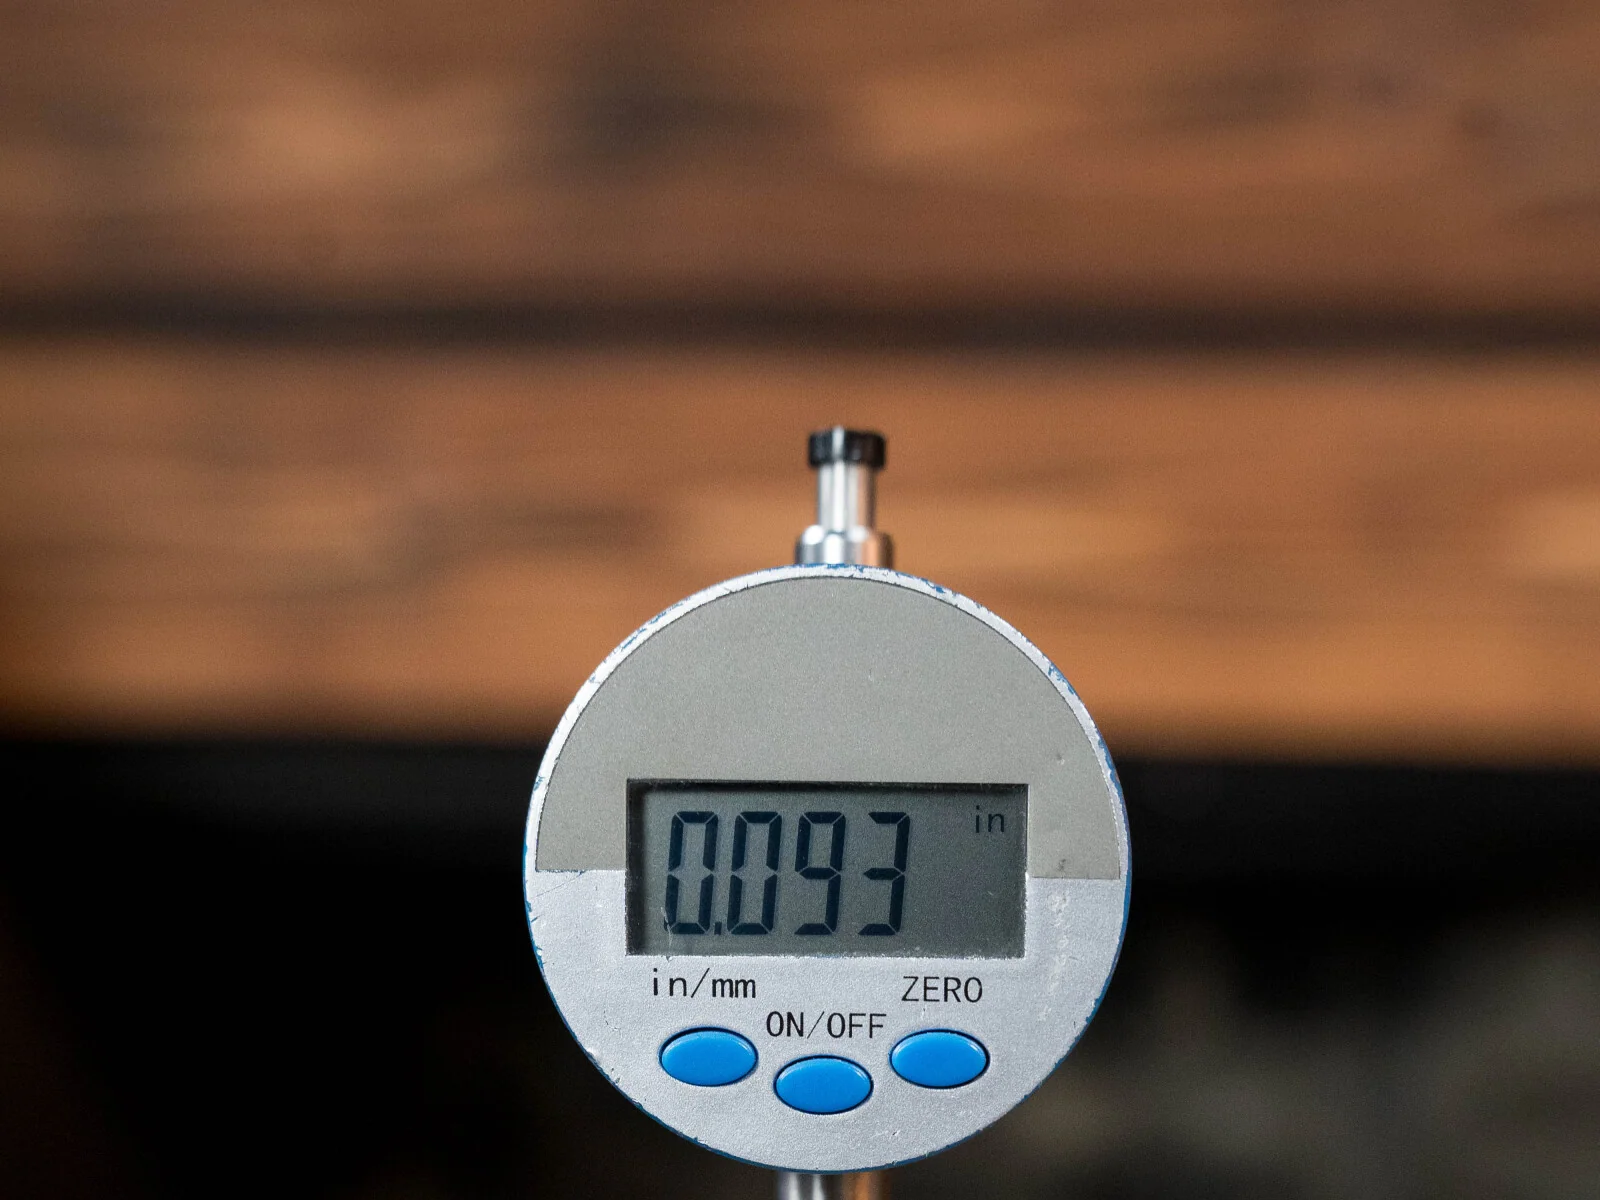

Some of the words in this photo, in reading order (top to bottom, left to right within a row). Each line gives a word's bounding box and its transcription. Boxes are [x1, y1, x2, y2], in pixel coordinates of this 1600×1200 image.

[664, 811, 911, 935] 0.093
[974, 806, 1006, 834] in
[652, 968, 756, 999] in/mm
[901, 976, 983, 1003] ZERO
[766, 1011, 887, 1039] ON/OFF
